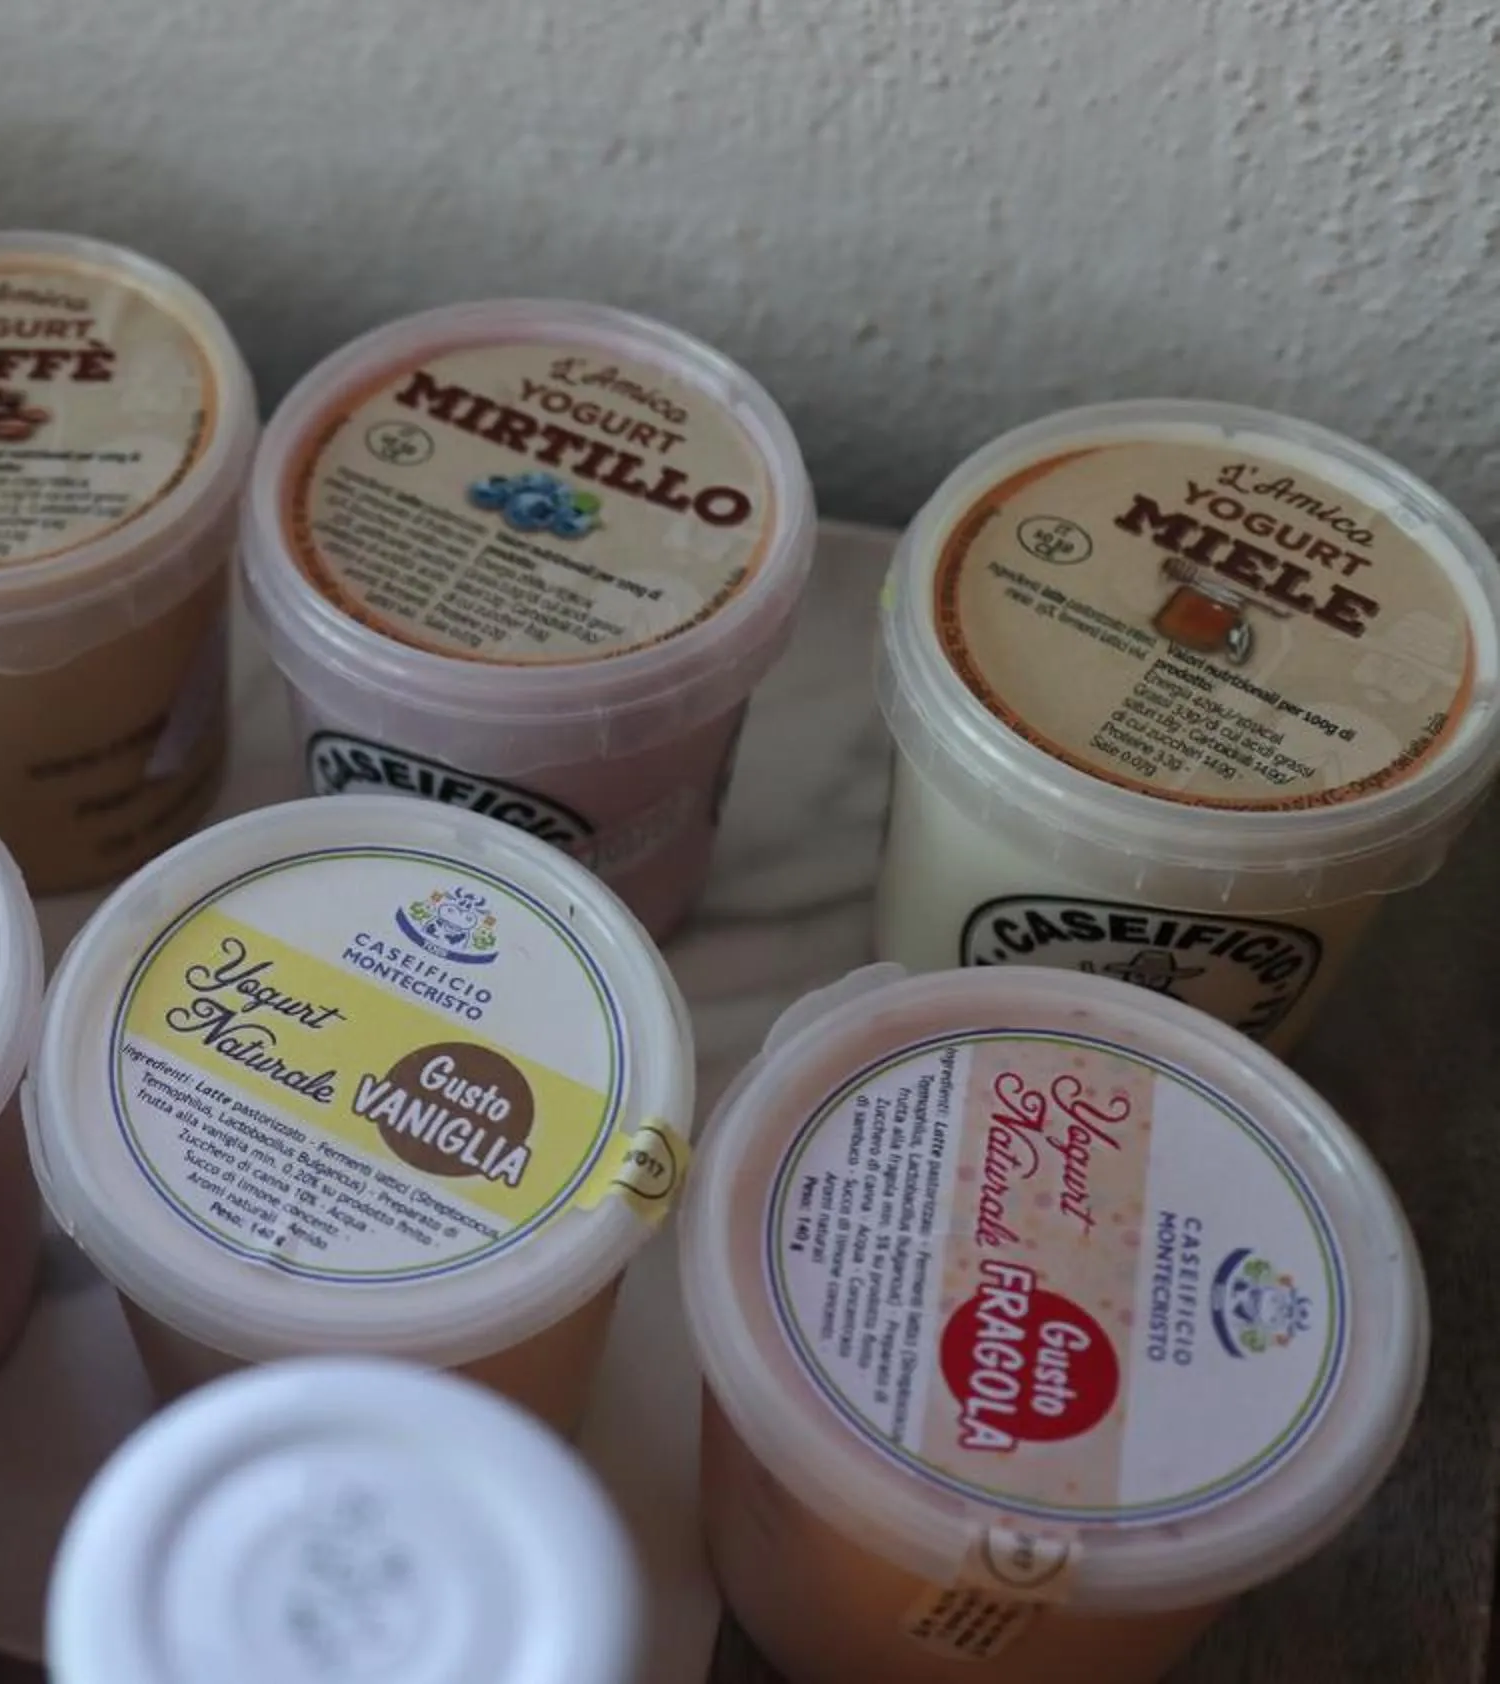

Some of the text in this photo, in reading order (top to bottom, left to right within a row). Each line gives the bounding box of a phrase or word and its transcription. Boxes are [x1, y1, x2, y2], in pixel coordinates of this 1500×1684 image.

[397, 371, 753, 527] MIRTILLO
[519, 379, 685, 455] YOGURT
[1185, 480, 1373, 579] YOGURT
[1217, 463, 1377, 549] L'Amica
[1114, 493, 1381, 639] MIELE
[1276, 697, 1304, 720] per
[1300, 709, 1339, 737] 100g
[1338, 728, 1358, 742] di
[184, 936, 346, 1033] Yogurt
[340, 946, 484, 1023] MONTECRISTO
[351, 931, 494, 1005] CASEIFICIO
[992, 909, 1304, 985] CASEIFICIO
[165, 996, 336, 1107] Naturale
[419, 1054, 511, 1123] Gusto
[193, 1078, 234, 1107] Latte
[231, 1098, 307, 1145] pastorizzato
[315, 1139, 373, 1176] Fermenti
[355, 1074, 531, 1188] VANIGLIA
[847, 1111, 867, 1166] sambuco
[855, 1094, 870, 1107] di
[867, 1097, 892, 1156] Zucchero
[889, 1125, 907, 1150] alla
[892, 1086, 913, 1123] frutta
[133, 1086, 175, 1116] frutta
[174, 1106, 201, 1129] alla
[320, 1182, 338, 1199] su
[336, 1189, 397, 1229] prodotto
[395, 1217, 435, 1246] finito
[217, 1110, 298, 1159] Lactobacillus
[376, 1190, 443, 1233] Preparato
[441, 1222, 460, 1240] di
[865, 1158, 883, 1172] di
[929, 1121, 948, 1157] Latte
[975, 1071, 1049, 1250] Naturale
[1050, 1074, 1131, 1234] Yogurt
[177, 1127, 369, 1234] Zucchero di canna 10% Acqua
[181, 1148, 284, 1208] Succo di limone
[184, 1168, 227, 1198] Aromi
[820, 1170, 840, 1211] Aromi
[839, 1177, 858, 1215] Succo
[860, 1173, 880, 1213] canna
[794, 1216, 813, 1241] 140
[851, 1224, 873, 1264] Acqua
[1146, 1210, 1178, 1363] MONTECRISTO
[1172, 1216, 1203, 1368] CASEIFICIO
[963, 1261, 1035, 1451] FRAGOLA
[1030, 1320, 1092, 1418] Gusto
